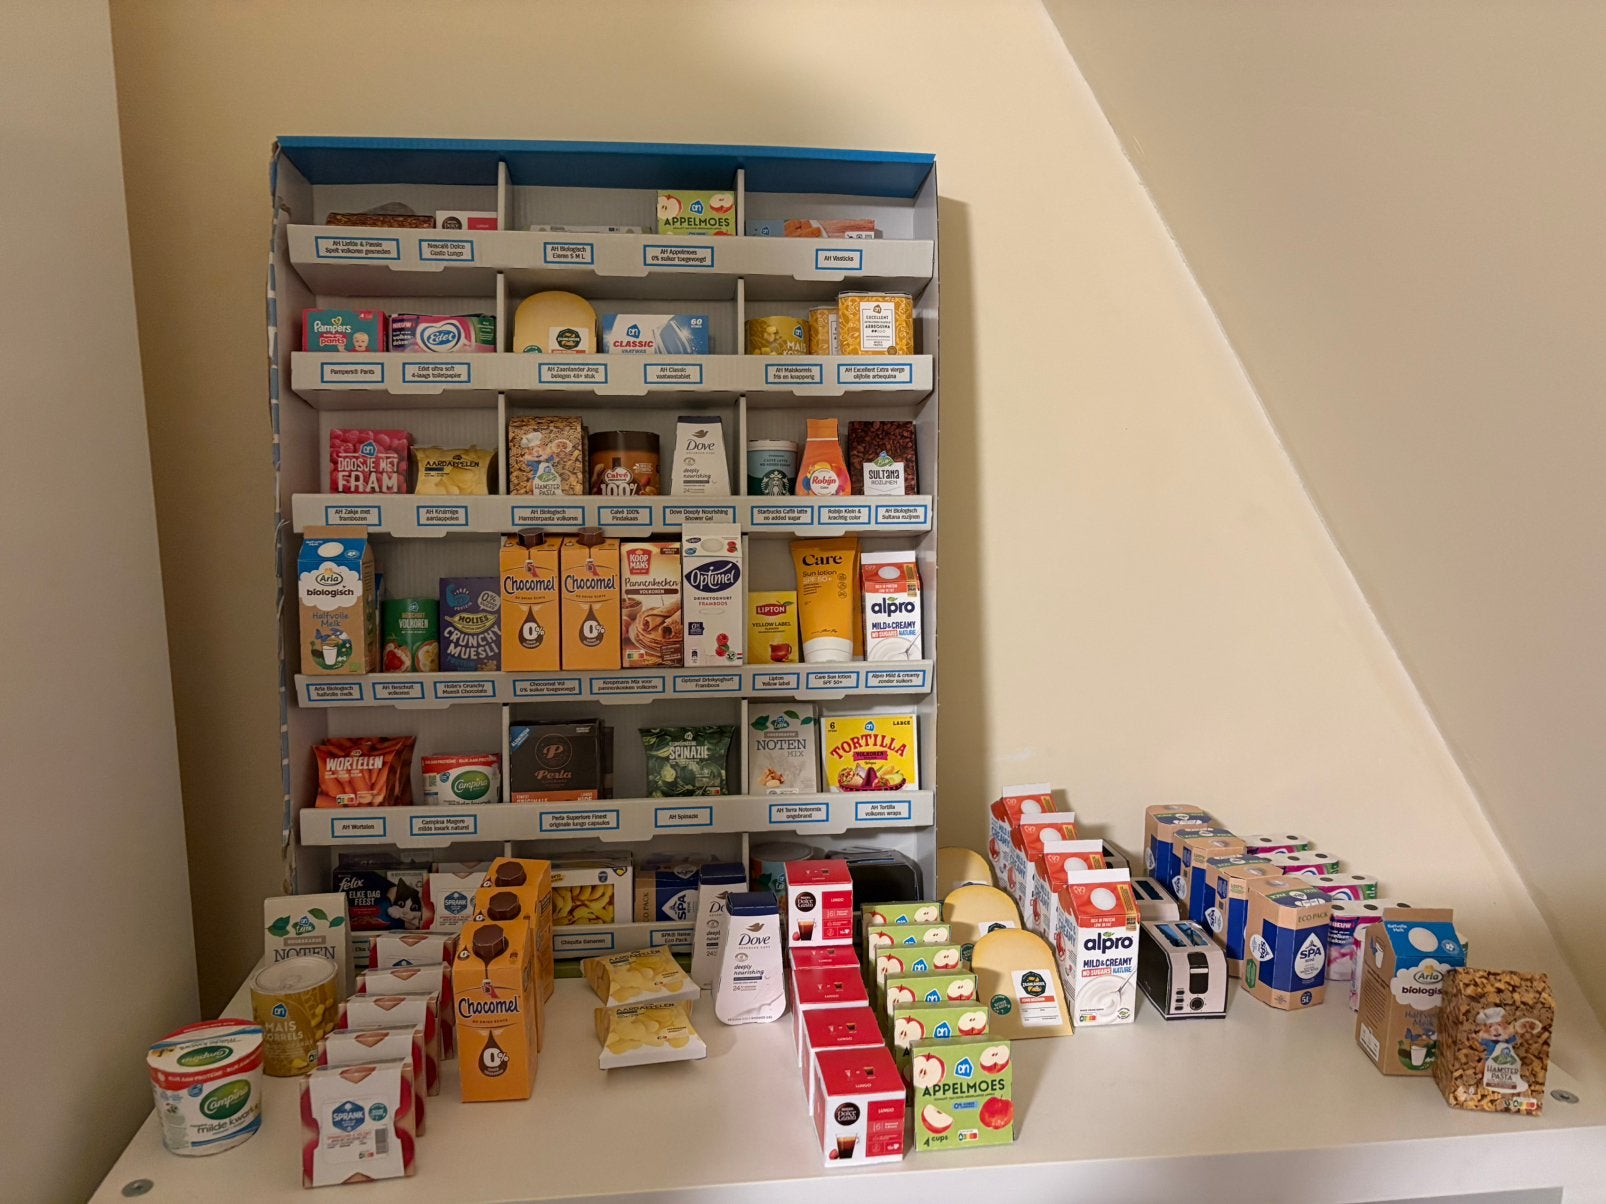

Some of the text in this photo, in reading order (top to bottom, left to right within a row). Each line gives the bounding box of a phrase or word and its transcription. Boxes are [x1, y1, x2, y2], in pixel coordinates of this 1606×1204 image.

[664, 217, 730, 227] APPELMOES
[314, 320, 352, 333] Pampers
[691, 318, 702, 326] 60
[429, 331, 454, 342] Edet
[614, 340, 653, 348] CLASSIC
[687, 440, 715, 451] Dove
[338, 458, 398, 471] DOOSJE MET
[338, 472, 398, 493] FRAM
[812, 475, 837, 486] Robijn
[535, 483, 560, 491] HAMSTER
[601, 483, 637, 495] 100%
[630, 554, 649, 562] KOOP
[802, 555, 842, 567] Care
[629, 561, 649, 569] MANS
[320, 575, 339, 583] Arla
[690, 563, 736, 590] Optimel
[816, 569, 837, 577] lotion
[504, 576, 555, 594] Chocomel
[564, 575, 616, 593] Chocomel
[625, 578, 679, 589] Pannenkoeken
[306, 588, 354, 598] biologisch
[758, 606, 785, 614] LIPTON
[871, 597, 915, 617] alpro
[312, 612, 348, 620] Halfvolle
[320, 619, 341, 627] Melk
[582, 620, 605, 638] 0%
[444, 626, 502, 646] CRUNCHY
[522, 621, 545, 639] 0%
[447, 644, 498, 659] MUESLI
[757, 739, 807, 751] NOTEN
[830, 734, 908, 760] TORTILLA
[670, 746, 709, 760] SPINAZIE
[326, 755, 384, 770] WORTELEN
[535, 769, 571, 779] Perla
[454, 779, 488, 792] Campina
[349, 890, 380, 899] ELKE DAG
[355, 898, 375, 906] FEEST
[677, 894, 686, 920] SPA
[1298, 911, 1328, 923] ECO PACK
[739, 933, 771, 946] Dove
[1083, 933, 1134, 954] alpro
[1299, 949, 1321, 960] SPA
[1091, 968, 1111, 976] SUGARS
[1113, 966, 1132, 974] NATURE
[1402, 986, 1442, 996] biologis
[459, 996, 521, 1018] Chocomel
[266, 1020, 298, 1031] MAIS
[483, 1046, 509, 1068] 0%
[1486, 1065, 1519, 1075] HAMSTER
[922, 1078, 1006, 1097] APPELMOES
[204, 1085, 249, 1114] Campina
[197, 1102, 259, 1134] milde kwark
[333, 1110, 365, 1120] SPRANK
[923, 1135, 949, 1147] 4 cups
